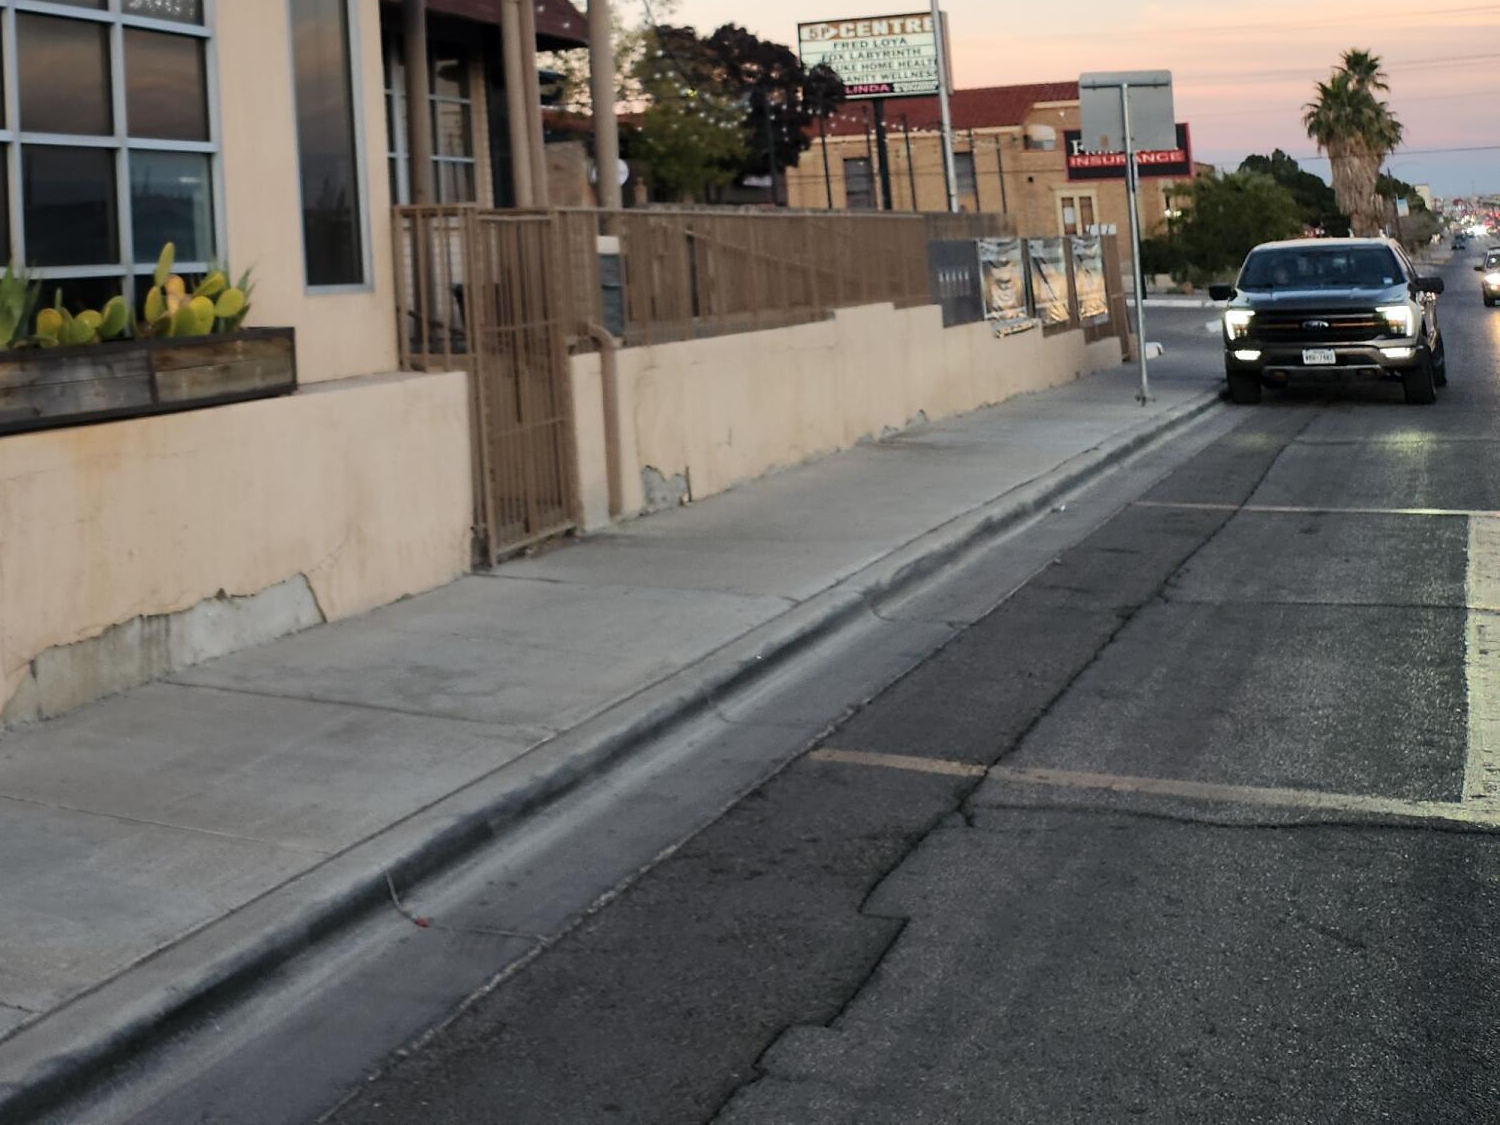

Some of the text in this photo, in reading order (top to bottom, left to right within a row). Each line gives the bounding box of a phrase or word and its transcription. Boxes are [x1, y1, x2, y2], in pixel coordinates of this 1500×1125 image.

[833, 37, 908, 50] FRED LOYA
[850, 48, 922, 61] LABYRINTH
[862, 61, 893, 71] HOME
